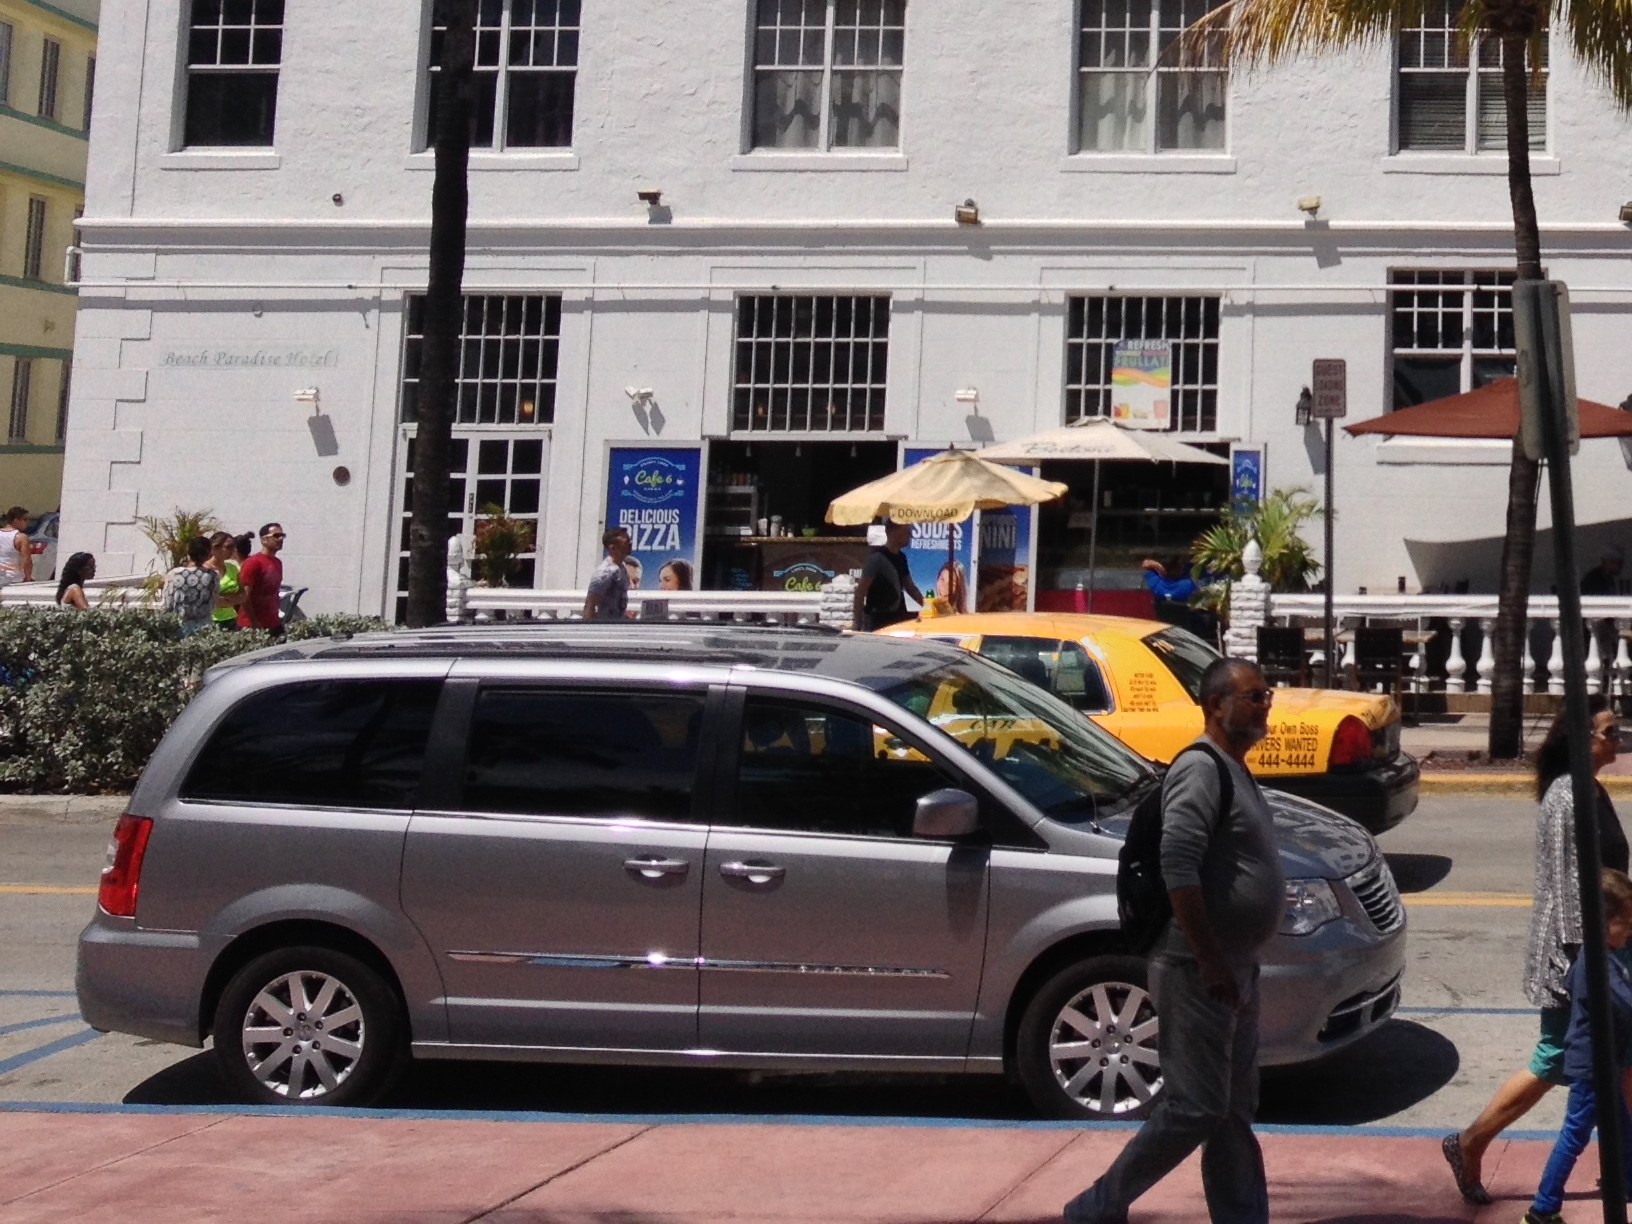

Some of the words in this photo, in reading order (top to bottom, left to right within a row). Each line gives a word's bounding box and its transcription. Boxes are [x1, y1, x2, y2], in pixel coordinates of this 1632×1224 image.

[165, 350, 208, 366] Beach
[216, 350, 281, 366] Paradise
[285, 350, 332, 366] Hotel
[1318, 394, 1341, 407] ZONE
[634, 469, 664, 488] Cafe
[665, 474, 673, 484] 6
[619, 508, 680, 524] DELICIOUS
[897, 507, 959, 519] DOWNLOAD
[910, 537, 962, 551] REFRESHMETS
[981, 525, 1016, 549] NINI
[1280, 721, 1297, 735] Own
[1299, 721, 1319, 735] Boss
[1252, 737, 1281, 751] IVERS
[1284, 737, 1318, 752] WANTED
[1258, 753, 1315, 768] 444-4444
